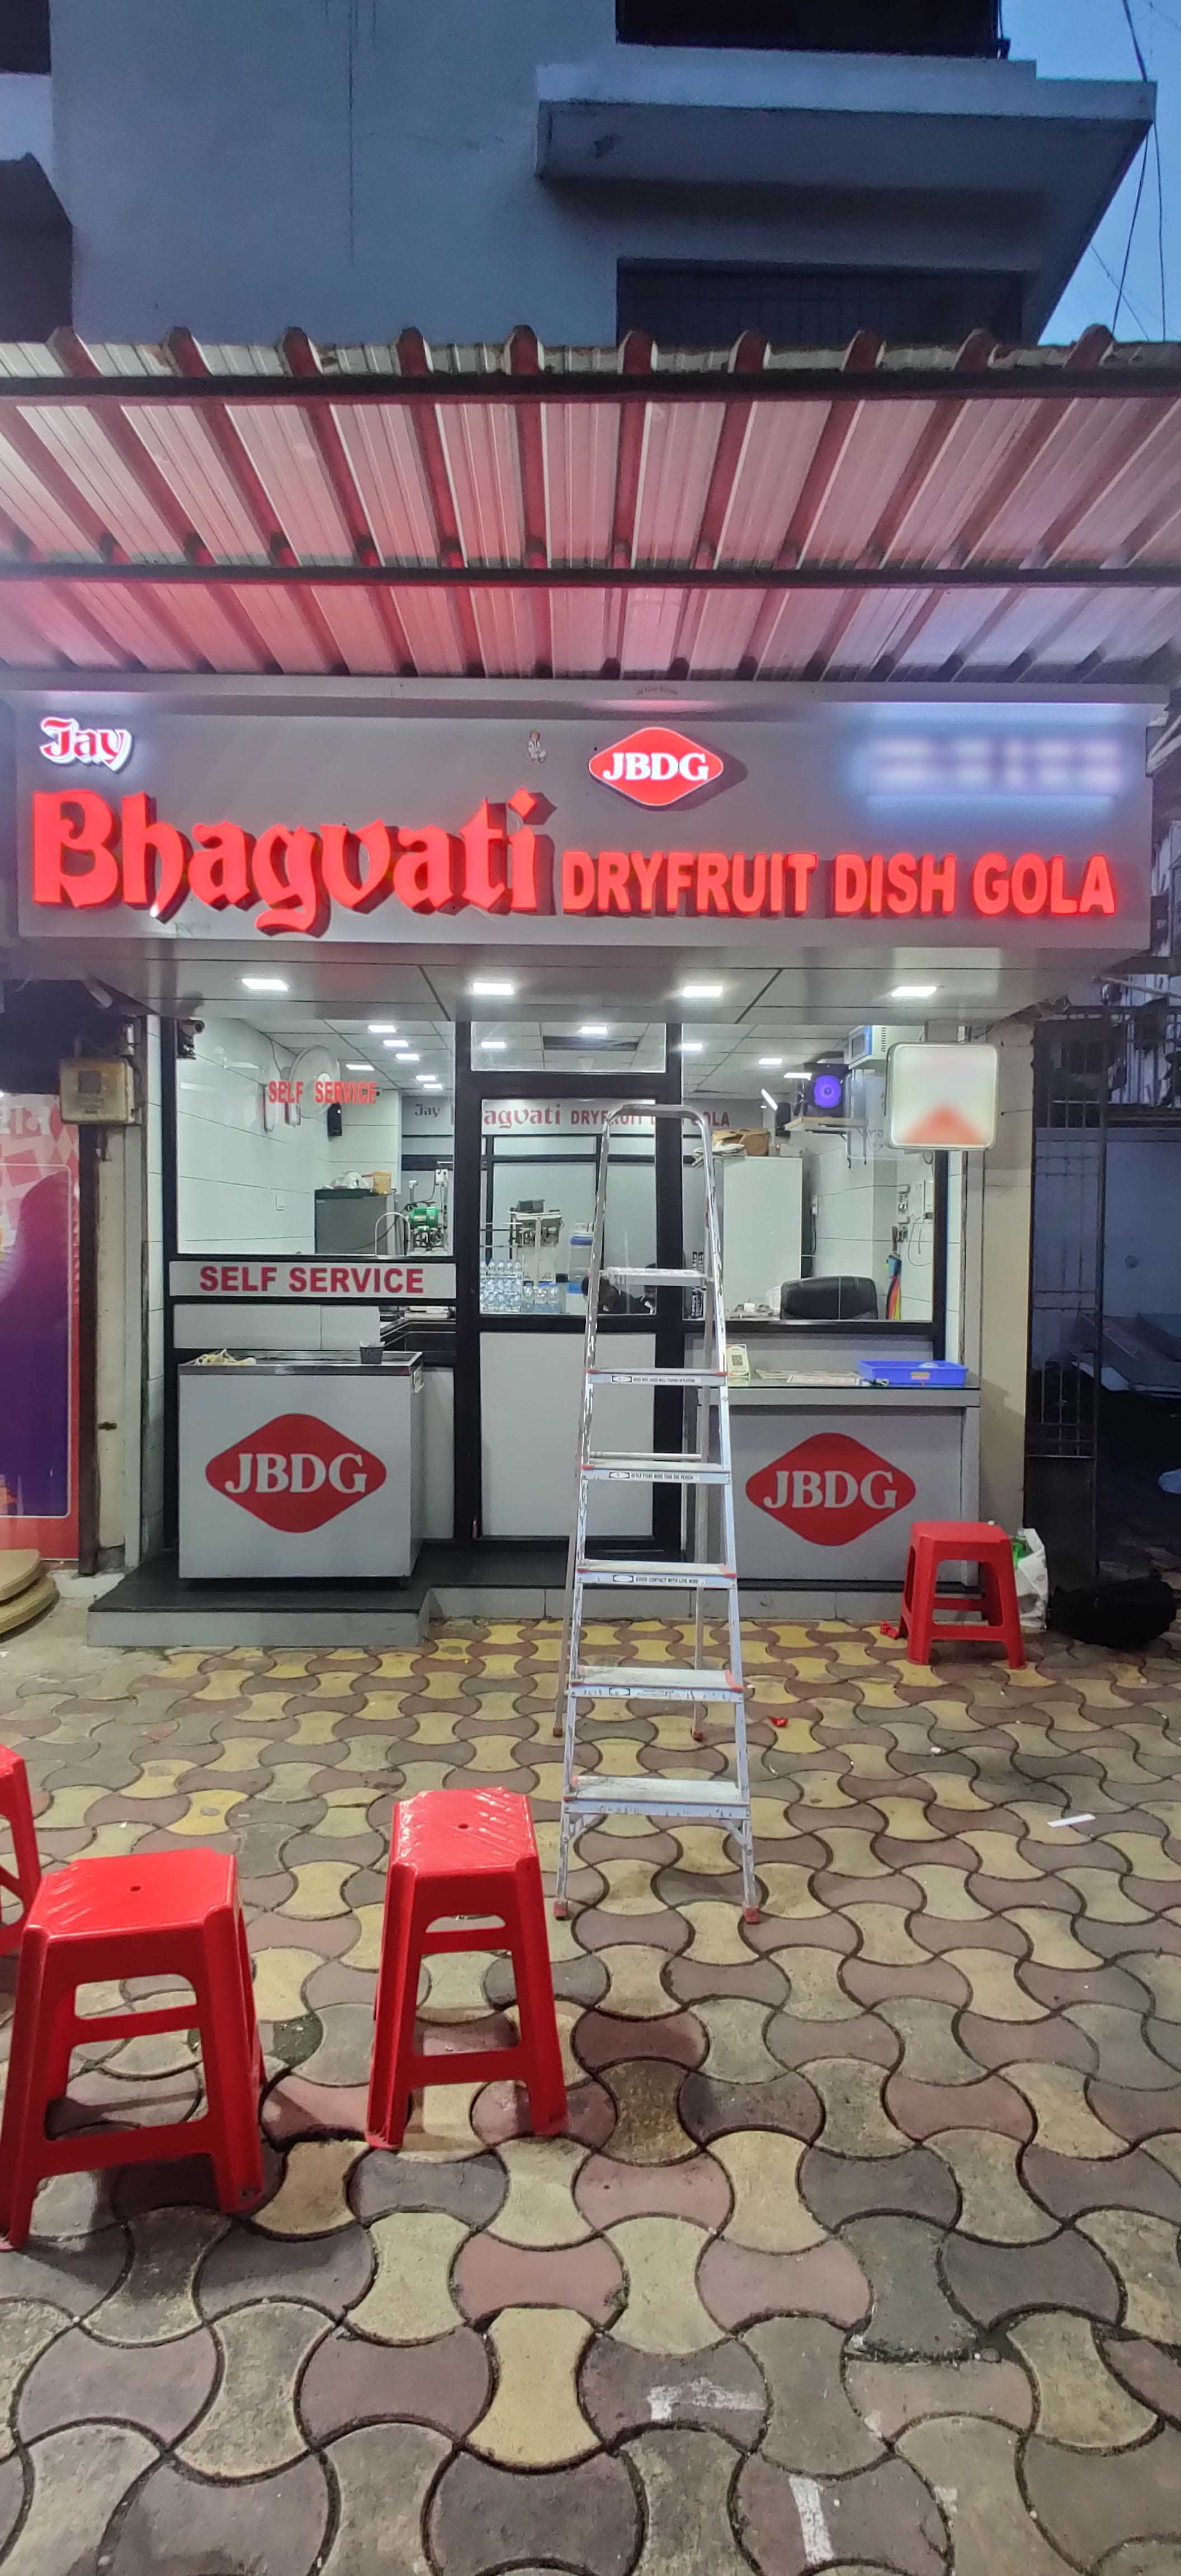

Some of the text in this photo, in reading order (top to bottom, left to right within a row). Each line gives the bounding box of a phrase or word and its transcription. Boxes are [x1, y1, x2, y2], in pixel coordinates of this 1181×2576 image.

[41, 717, 132, 770] Jay
[602, 751, 709, 781] JBDG
[33, 787, 1116, 937] Bhagvati DRYFRUIT DISH GOLA
[268, 1080, 376, 1104] SELF SERVICE
[414, 1104, 440, 1118] Jay
[483, 1104, 561, 1129] agvati
[200, 1266, 424, 1294] SELF SERVICE
[225, 1453, 367, 1494] JBDG
[763, 1470, 897, 1509] JBDG
